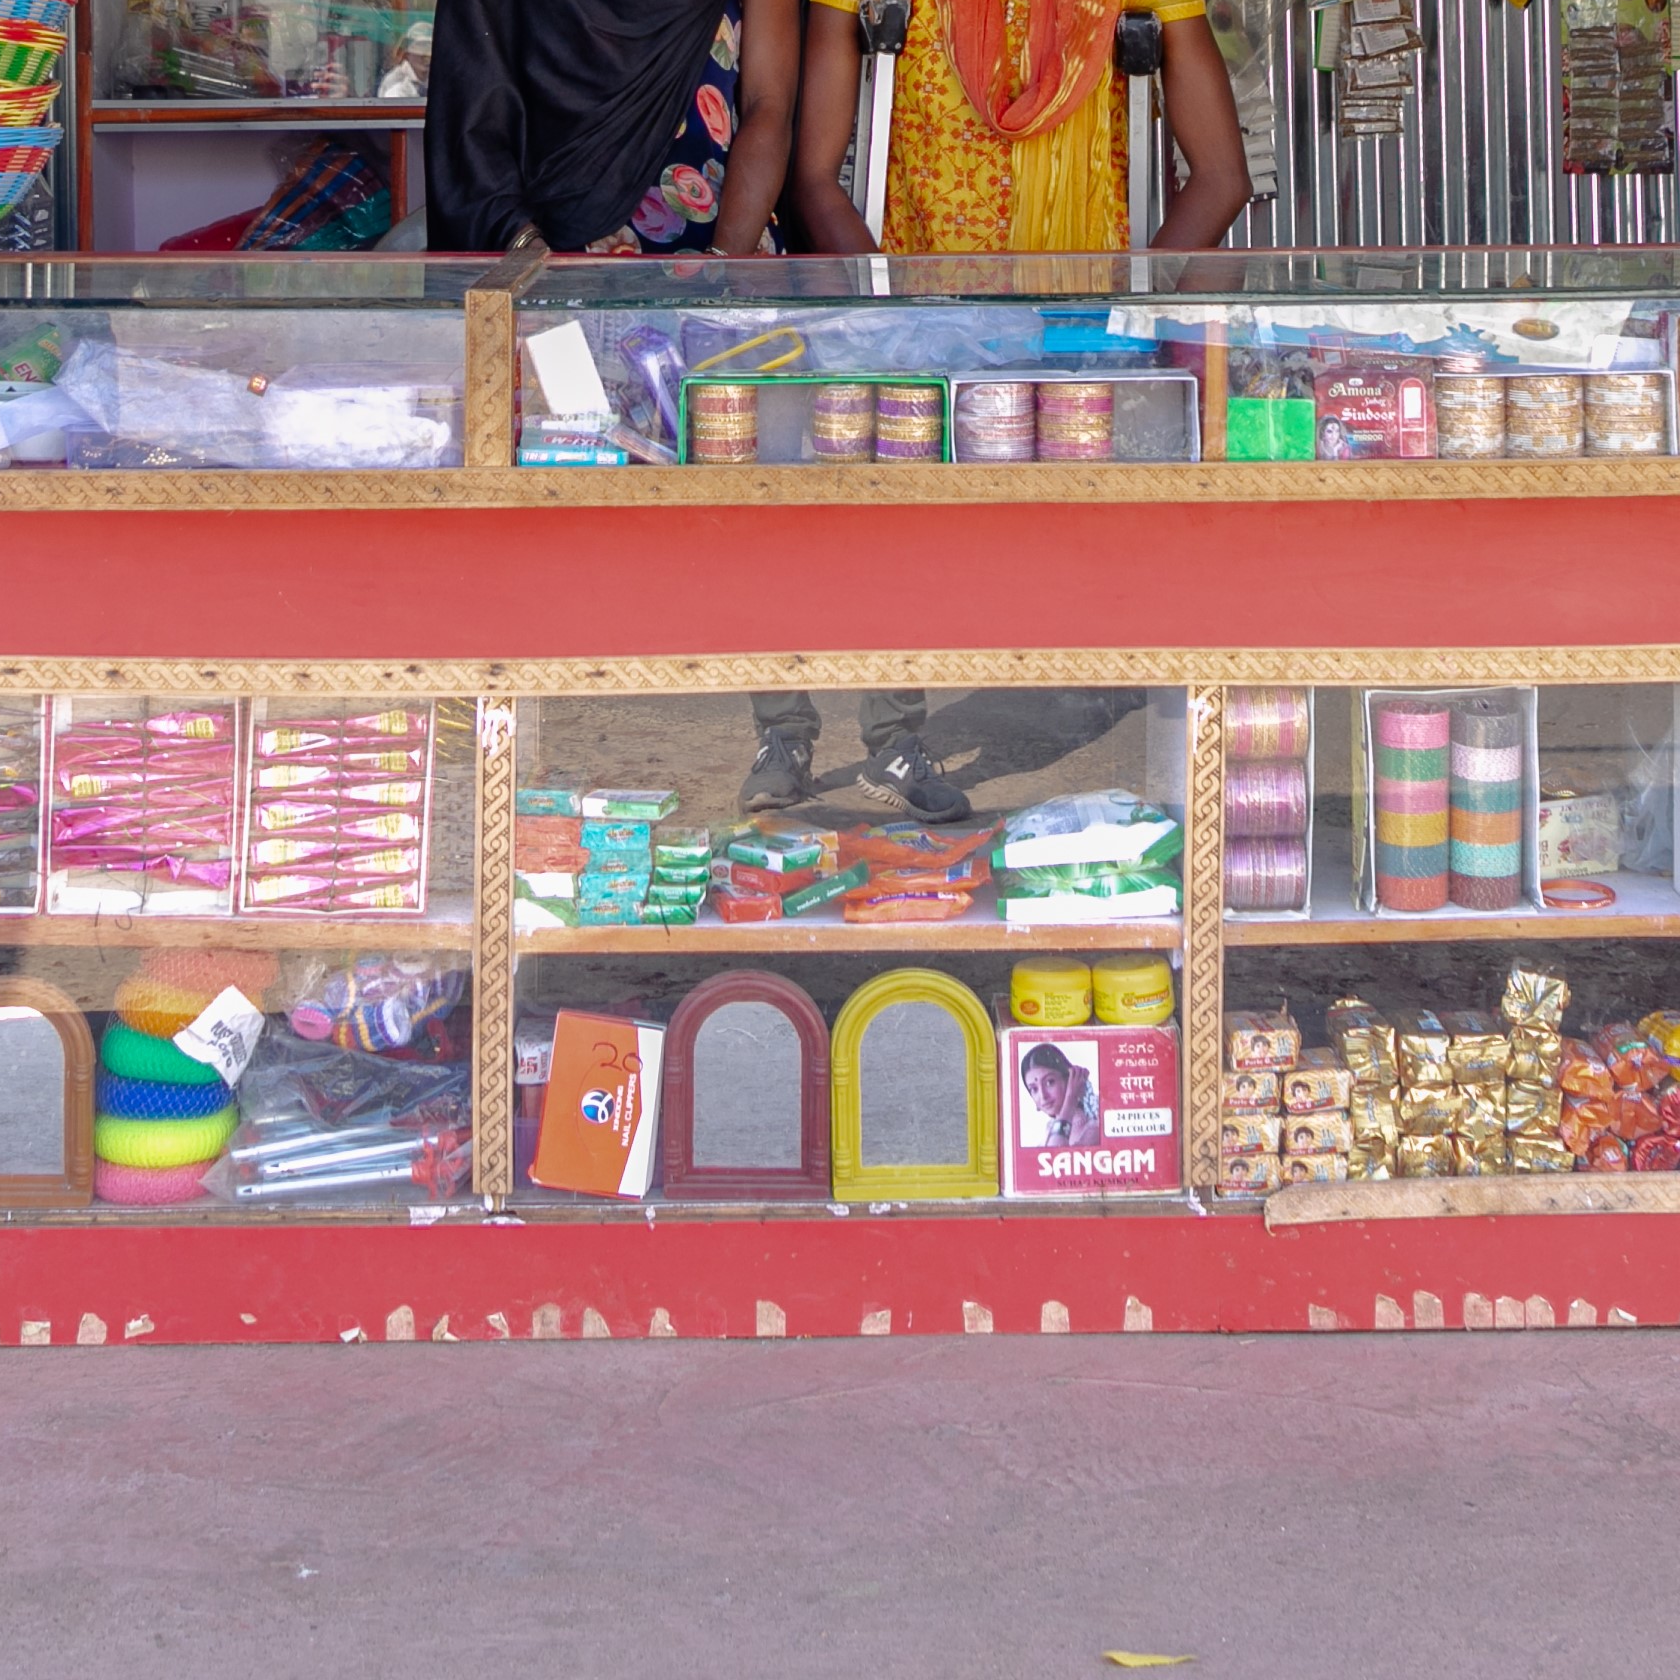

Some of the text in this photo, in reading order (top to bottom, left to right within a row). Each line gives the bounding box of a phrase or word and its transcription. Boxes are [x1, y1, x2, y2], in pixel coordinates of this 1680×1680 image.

[1328, 382, 1382, 398] Amona
[1340, 407, 1397, 421] Sindoor
[1353, 433, 1384, 442] MIRROR
[592, 1041, 644, 1073] 20
[1119, 1073, 1155, 1091] संगम
[621, 1073, 637, 1148] NAIL CLIPPERS
[1116, 1111, 1161, 1121] 24 PIECES
[1111, 1123, 1167, 1135] 4x1 COLOUR
[1037, 1147, 1156, 1179] SANGAM
